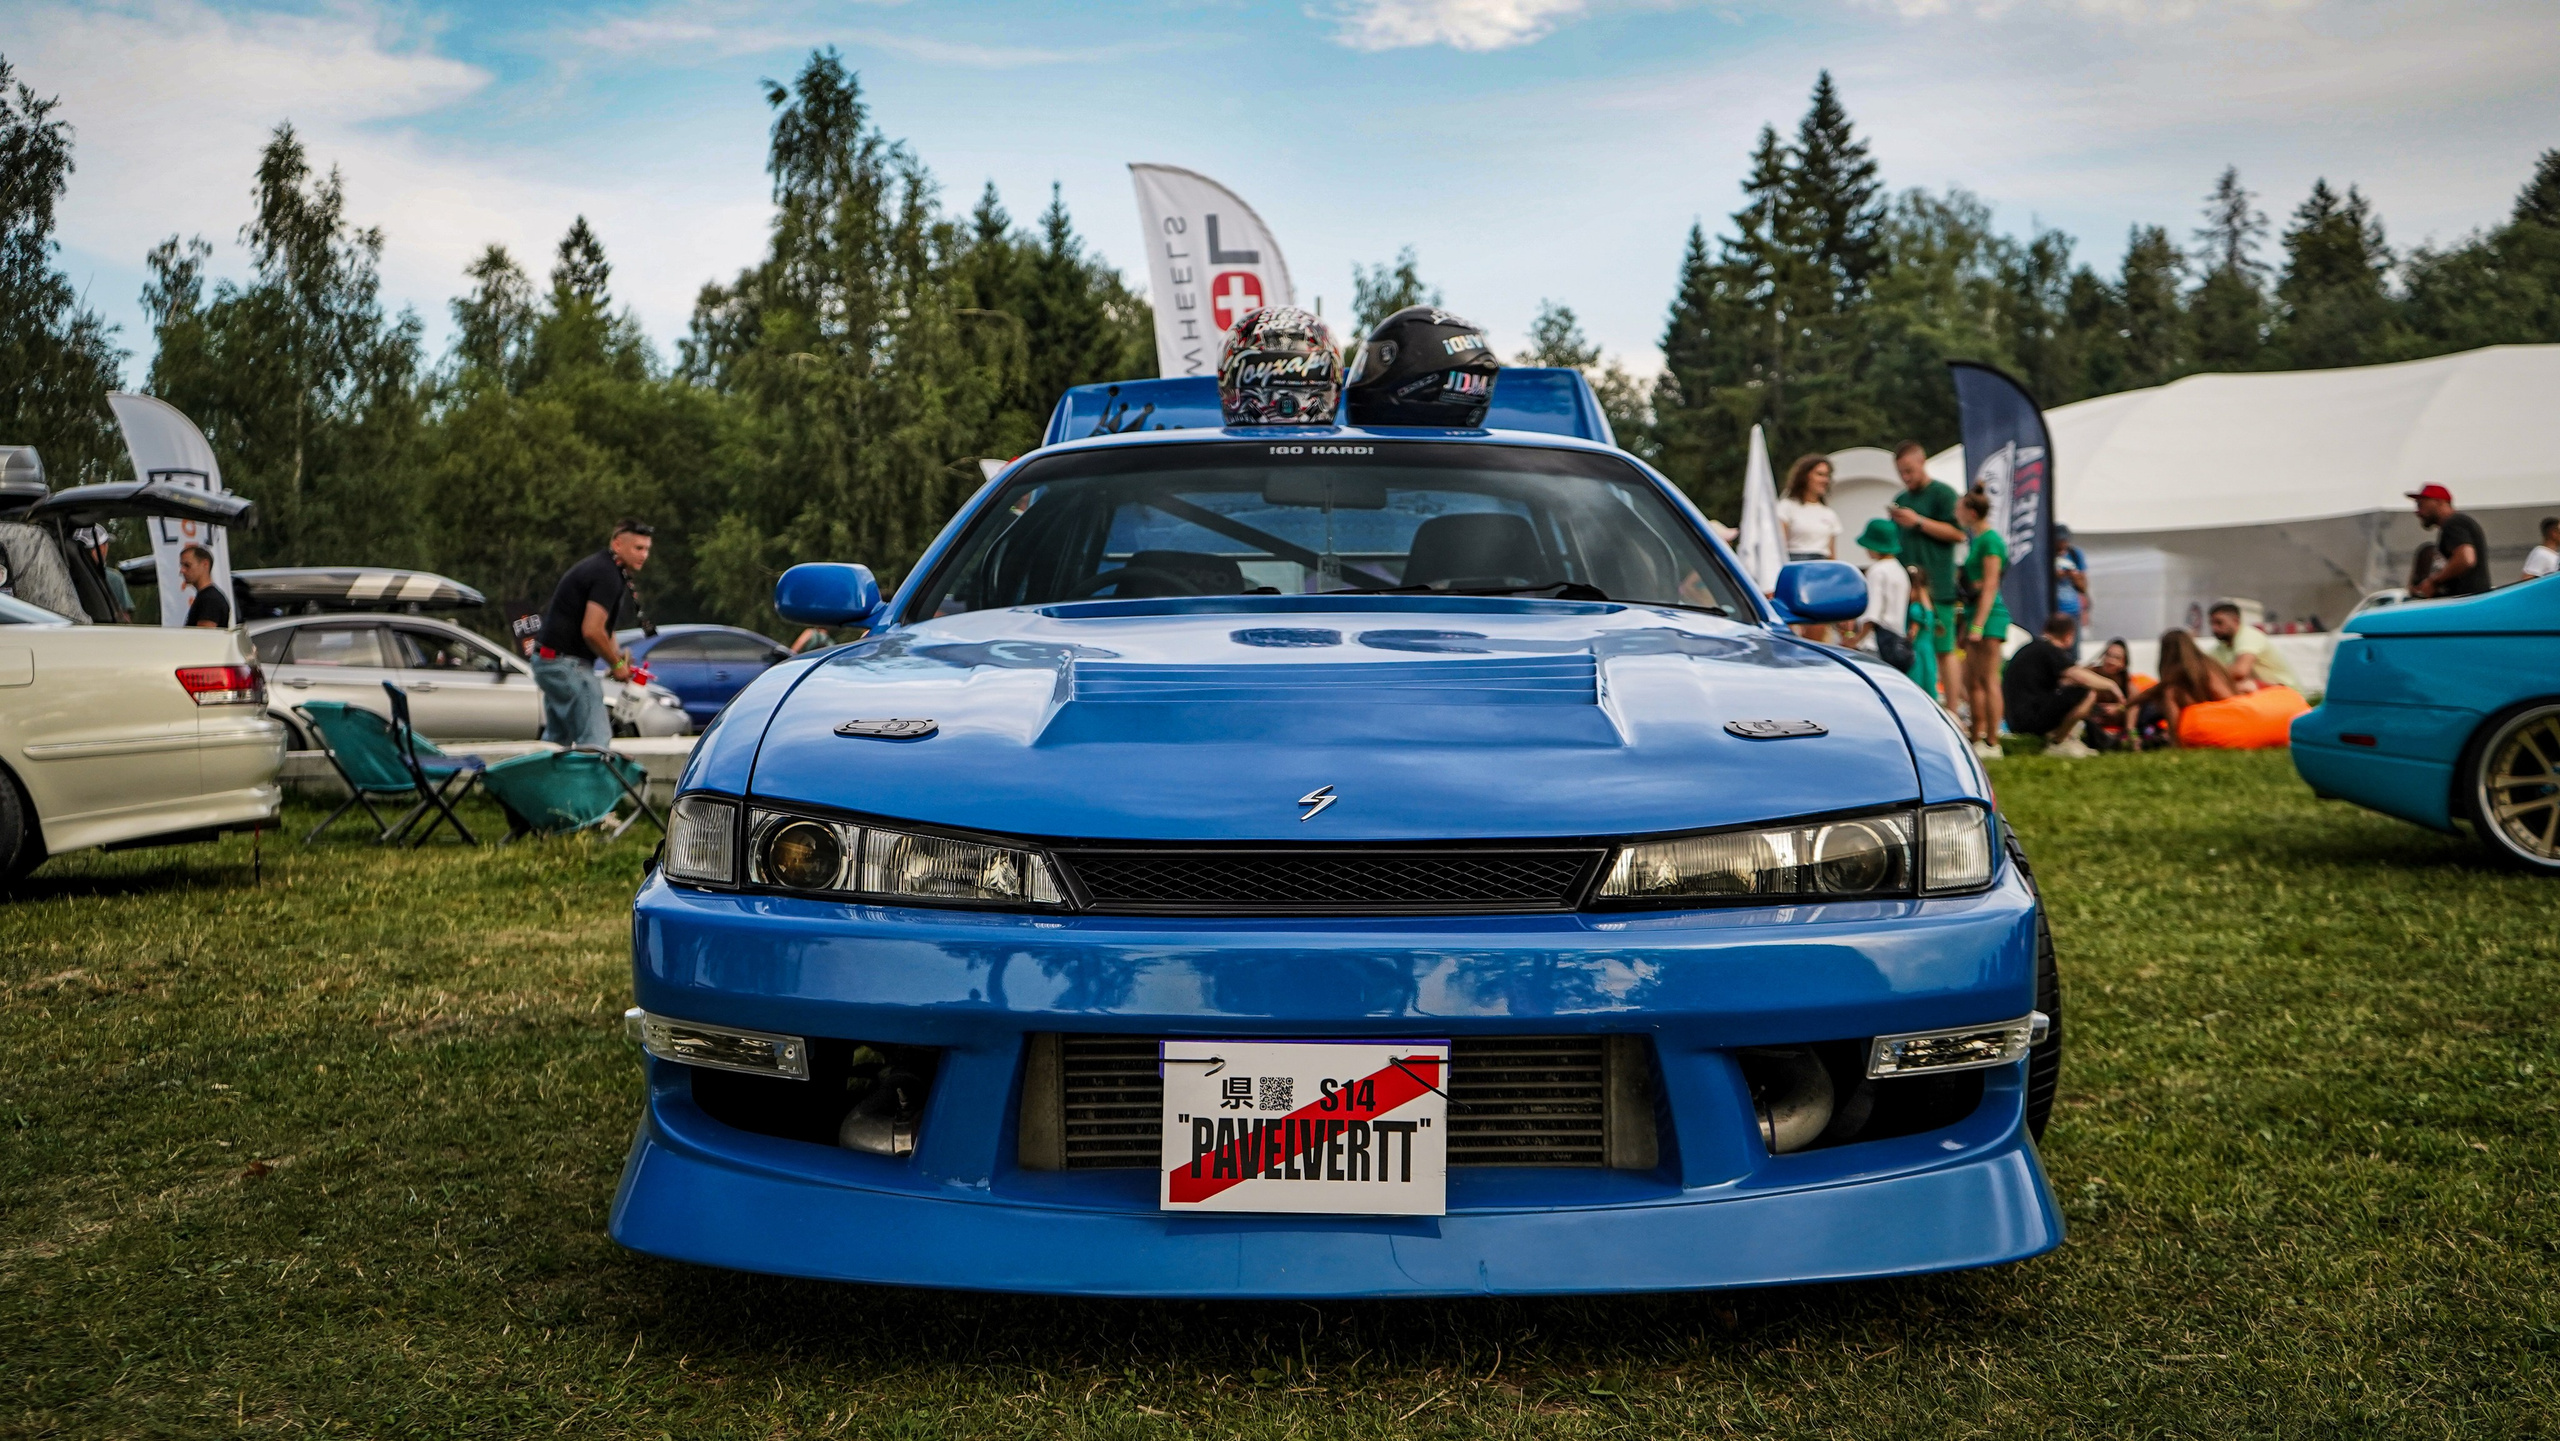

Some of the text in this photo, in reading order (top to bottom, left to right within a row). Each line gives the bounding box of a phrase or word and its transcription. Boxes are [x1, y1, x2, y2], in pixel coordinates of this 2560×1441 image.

[1443, 371, 1489, 395] JDM
[1311, 446, 1375, 455] HARD!
[1220, 1077, 1254, 1110] 県
[1319, 1078, 1376, 1112] S14
[1178, 1113, 1432, 1183] "PAVELVERTT"
